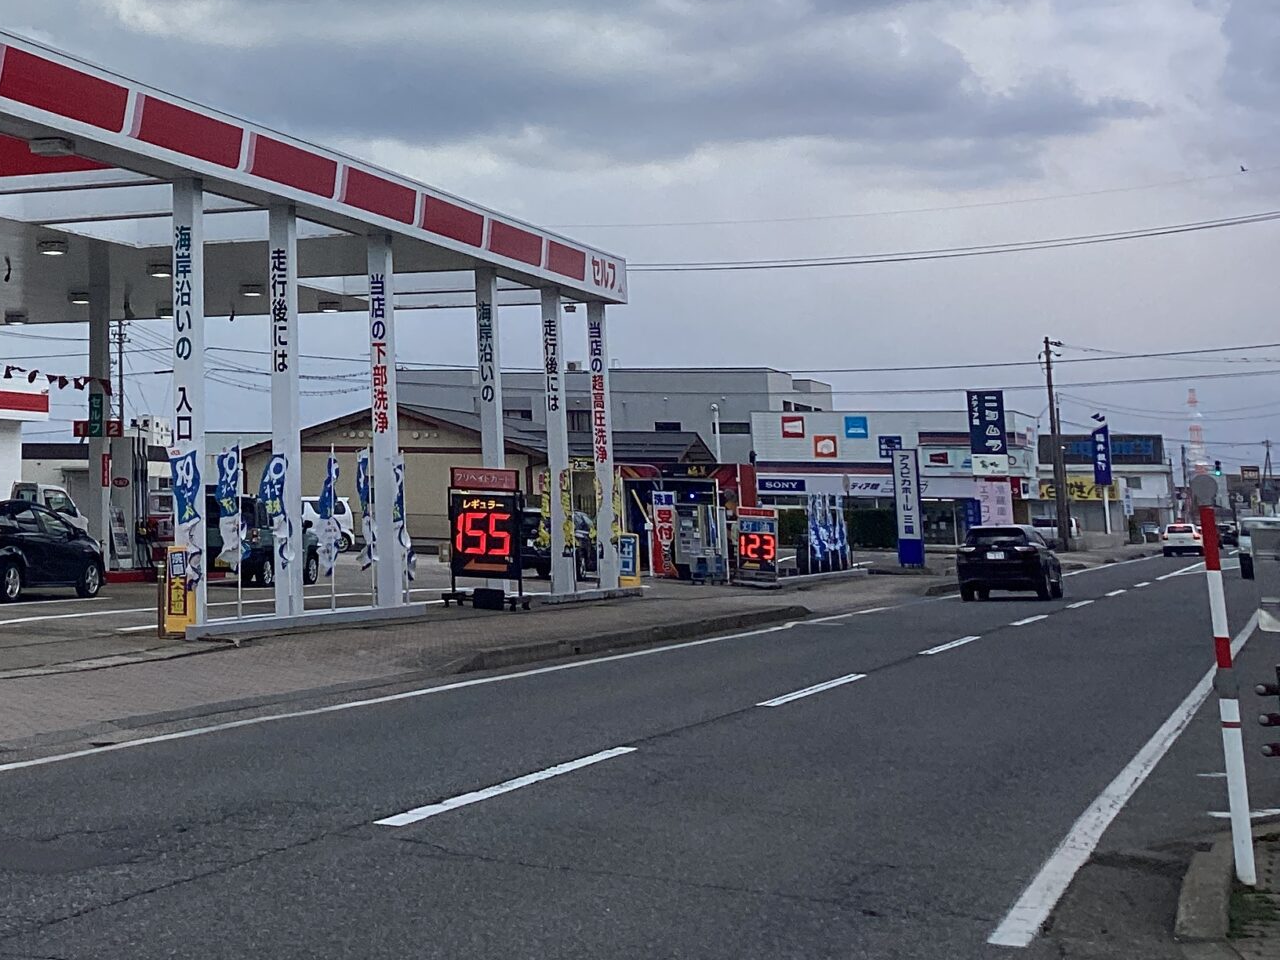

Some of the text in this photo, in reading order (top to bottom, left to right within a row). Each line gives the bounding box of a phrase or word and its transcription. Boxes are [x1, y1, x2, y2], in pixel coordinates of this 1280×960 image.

[592, 255, 616, 289] セルフ
[175, 225, 192, 361] 海岸沿いの
[271, 248, 288, 372] 走行後には
[370, 274, 389, 434] 当店の下部洗浄
[478, 302, 495, 403] 海岸沿いの
[544, 319, 559, 411] 走行後には
[588, 322, 608, 464] 当店の超高圧洗浄
[76, 423, 84, 434] 1
[90, 396, 101, 434] セルフ
[109, 423, 118, 435] 2
[176, 386, 192, 441] 入口
[463, 499, 504, 509] レギュラー
[765, 481, 798, 489] SONY
[851, 482, 880, 490] ディア館
[456, 512, 511, 555] 155
[740, 534, 775, 559] 123
